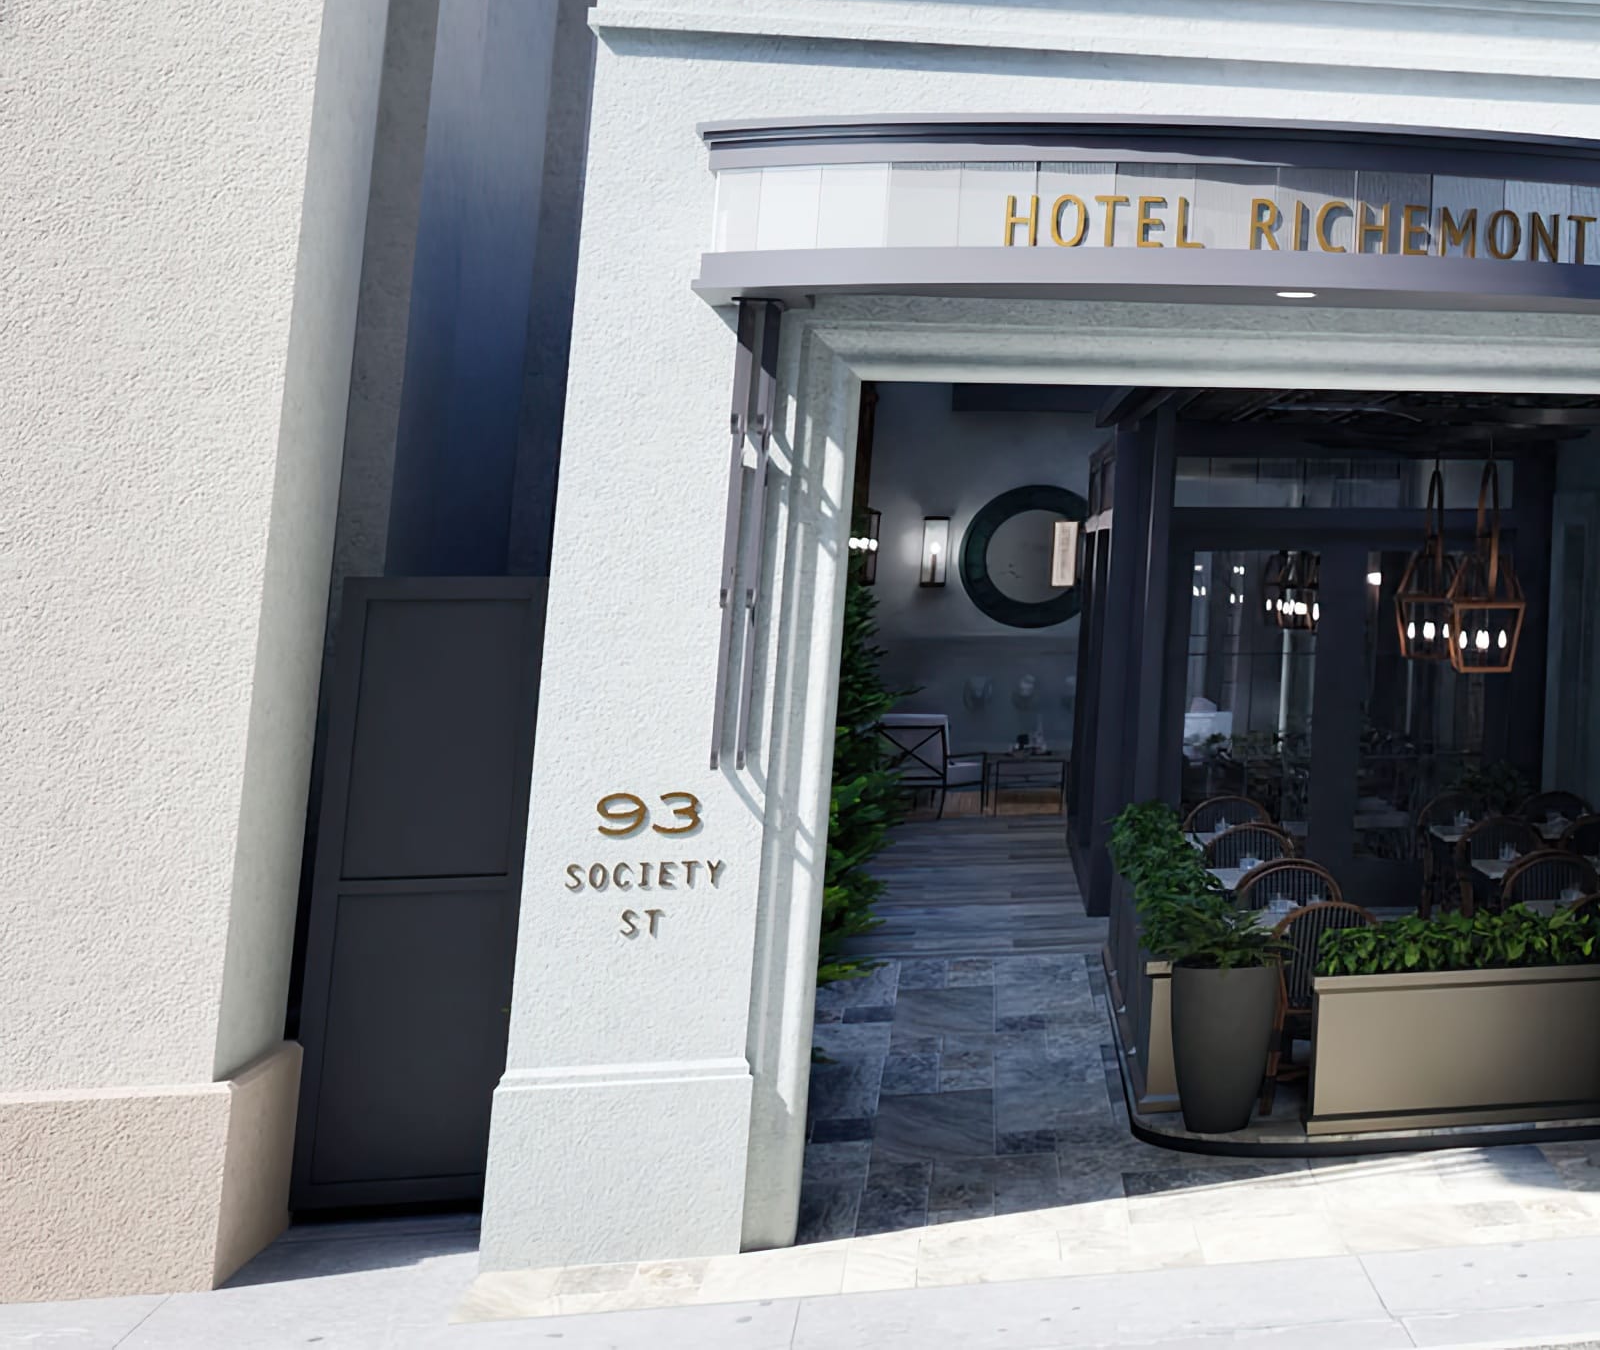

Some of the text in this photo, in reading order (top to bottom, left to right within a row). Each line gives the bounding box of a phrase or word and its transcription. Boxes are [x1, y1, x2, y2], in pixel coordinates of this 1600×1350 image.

[1004, 194, 1599, 265] HOTEL RICHEMONT
[596, 791, 701, 836] 93
[564, 859, 724, 890] SOCIETY
[619, 908, 665, 938] ST
